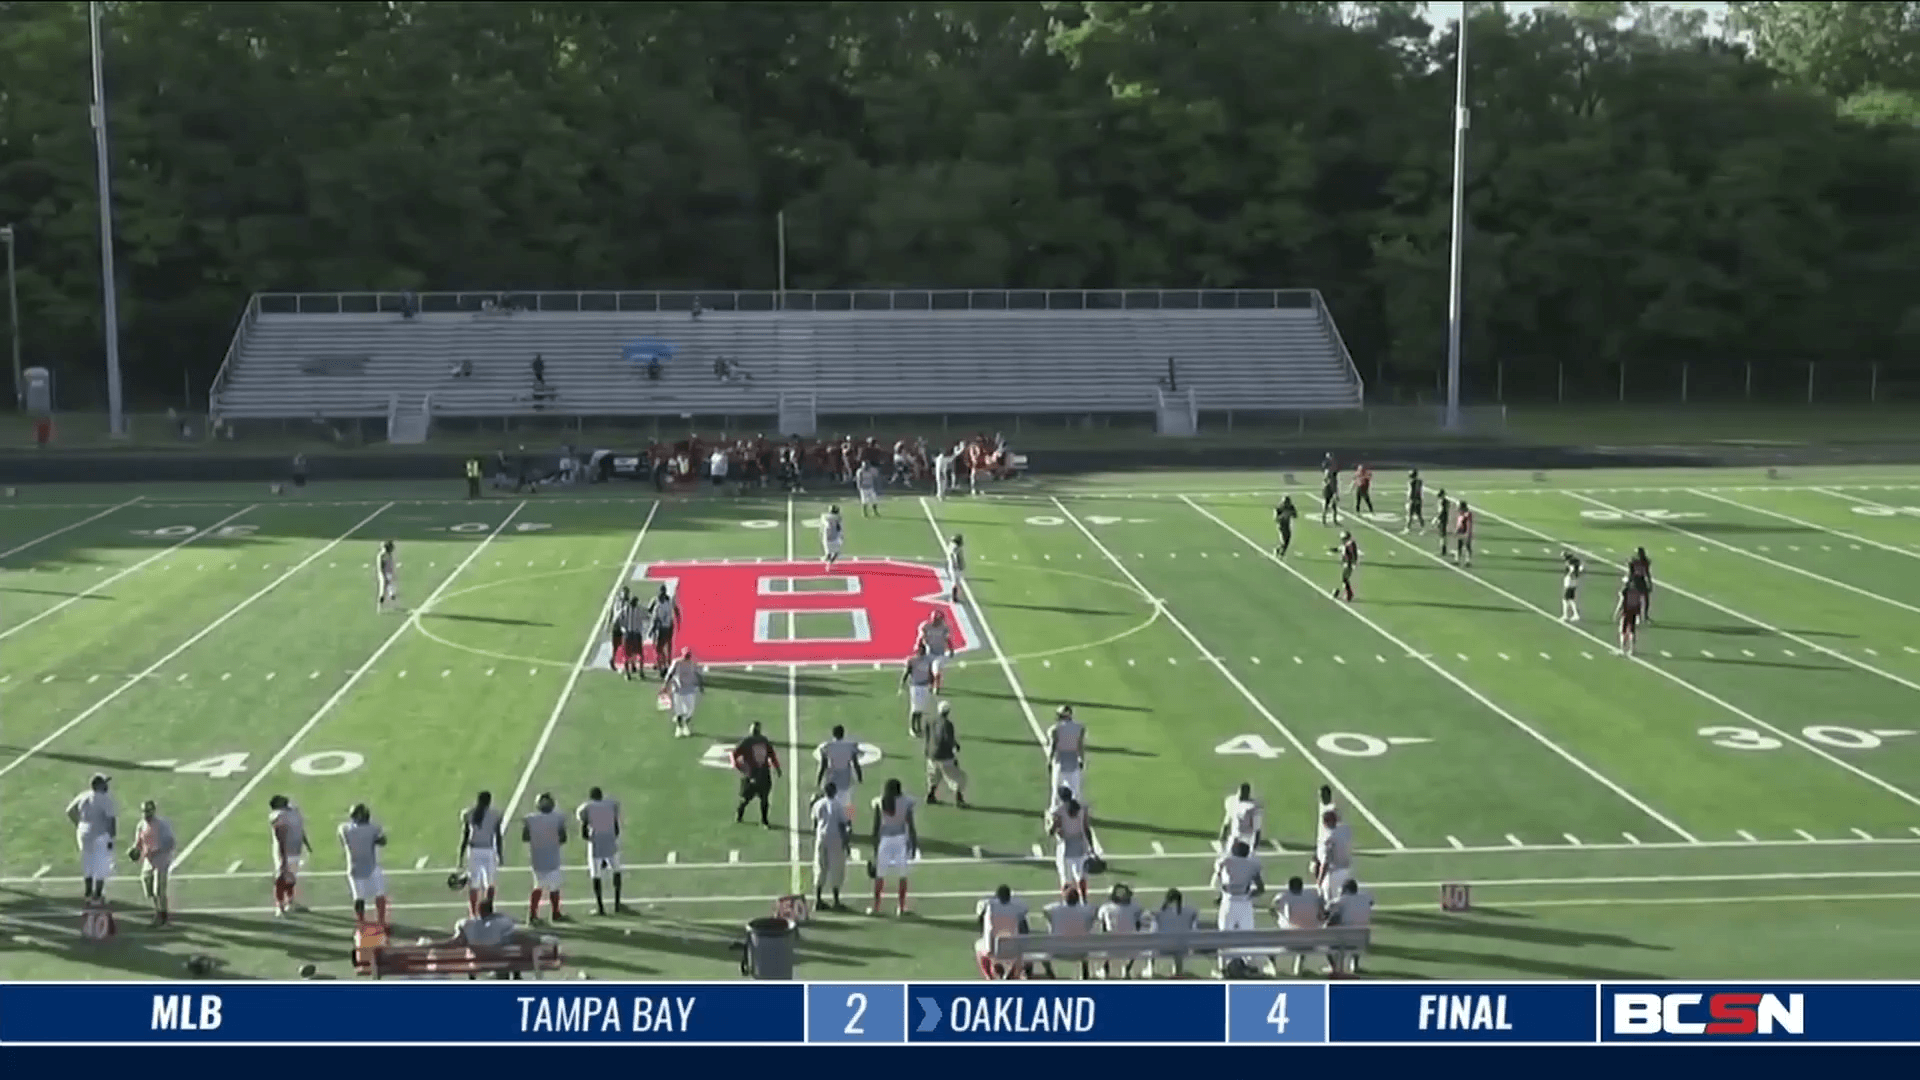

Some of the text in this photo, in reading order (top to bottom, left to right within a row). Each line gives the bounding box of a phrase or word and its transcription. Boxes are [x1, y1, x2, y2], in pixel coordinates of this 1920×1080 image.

[1214, 732, 1388, 758] 40
[1697, 725, 1881, 749] 30
[173, 750, 365, 778] 40
